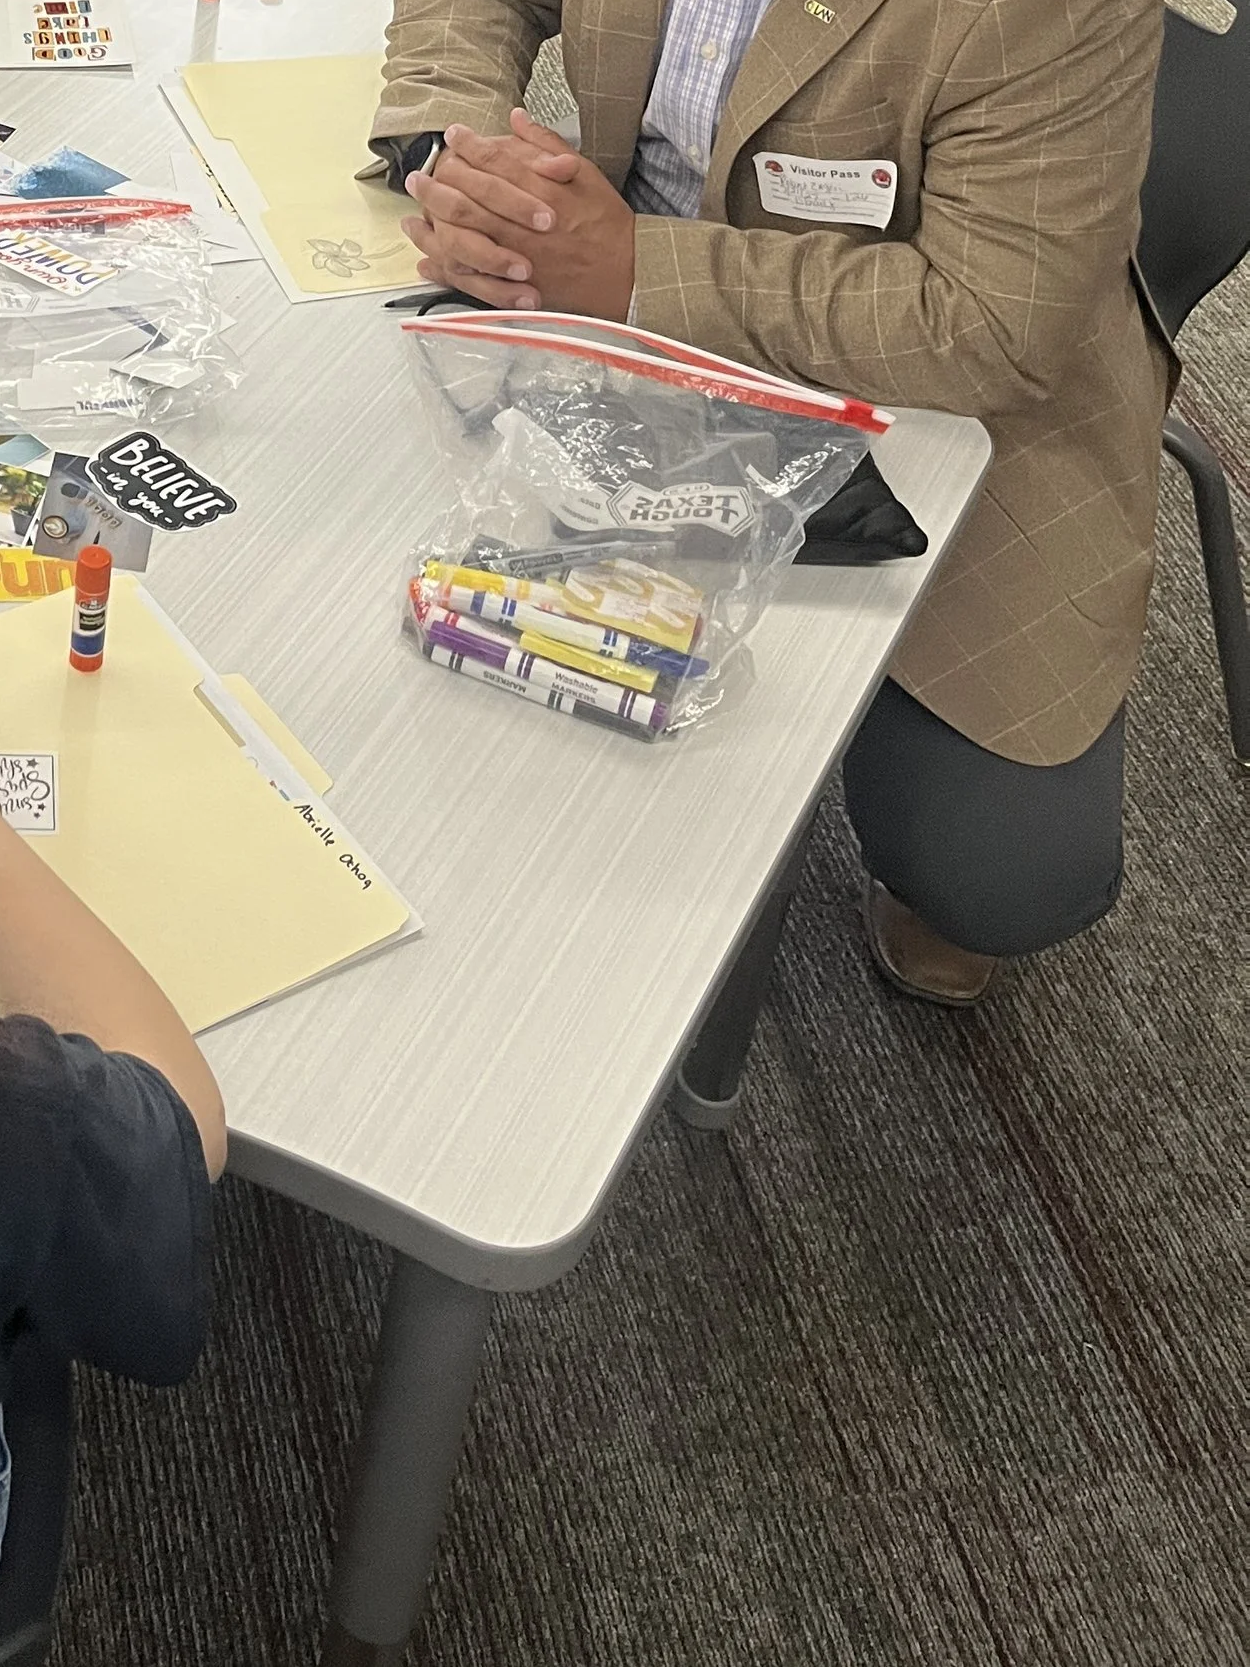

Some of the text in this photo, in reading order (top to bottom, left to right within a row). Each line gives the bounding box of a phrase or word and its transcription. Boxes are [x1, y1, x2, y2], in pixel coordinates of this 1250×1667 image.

[790, 164, 861, 179] Visitor Pass
[109, 437, 227, 521] BELIEVE
[483, 669, 527, 693] MARKERS
[553, 671, 599, 695] Washable
[551, 682, 597, 705] MARKERS
[294, 802, 373, 890] Abrielle Ochoa
